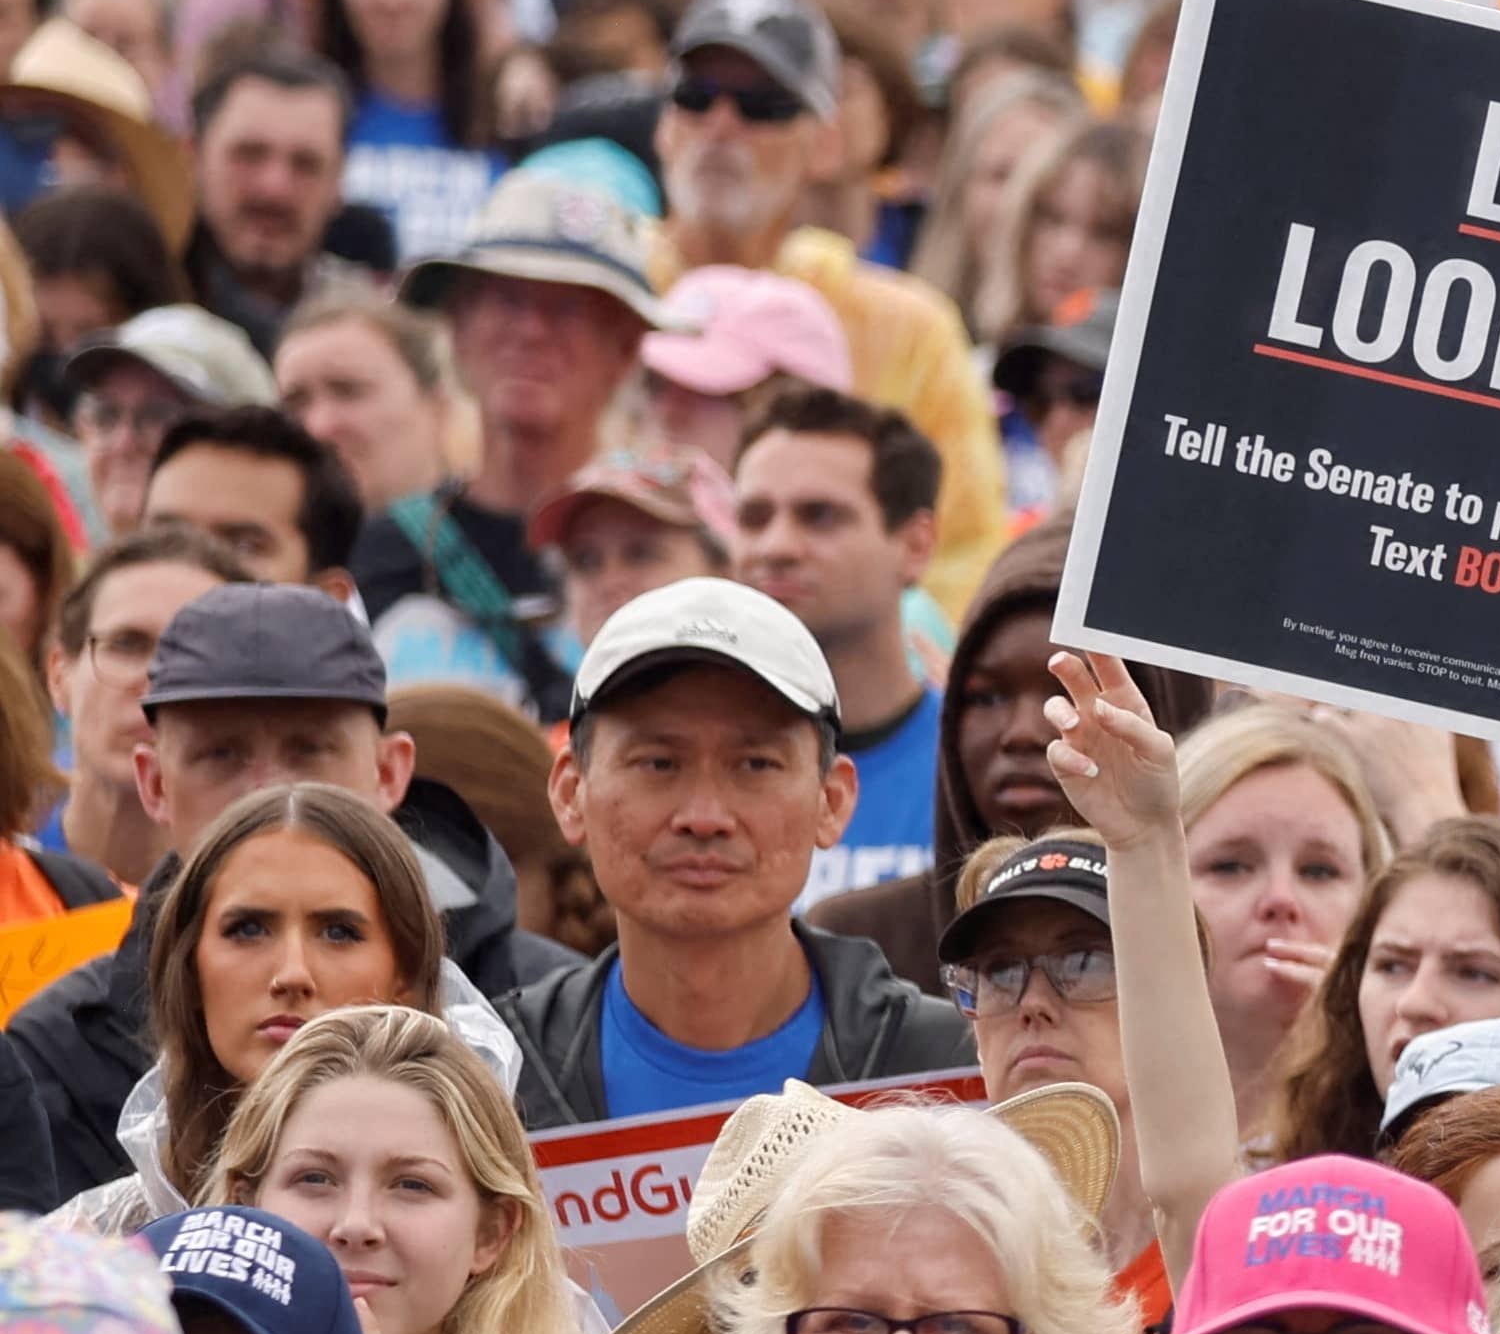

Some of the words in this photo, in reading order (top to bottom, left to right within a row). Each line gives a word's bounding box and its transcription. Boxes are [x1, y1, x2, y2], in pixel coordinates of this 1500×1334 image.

[1164, 414, 1227, 467] Tell
[1235, 435, 1295, 482] the
[1304, 448, 1434, 513] Senate
[1445, 483, 1483, 525] to
[1370, 525, 1447, 581] Text
[1282, 617, 1298, 631] By
[1299, 621, 1337, 640] texting,
[1338, 632, 1358, 644] you
[1359, 637, 1390, 651] agree
[1390, 642, 1403, 654] to
[1403, 647, 1441, 663] receive
[1334, 642, 1358, 660] Msg
[1359, 648, 1381, 665] freq
[1382, 656, 1415, 671] varies.
[1416, 662, 1448, 677] STOP
[1448, 669, 1460, 681] to
[1461, 674, 1485, 687] quit.
[1257, 1183, 1386, 1216] MARCH
[179, 1210, 283, 1250] MARCH
[1245, 1232, 1343, 1267] LIVES
[1248, 1208, 1317, 1242] FOR
[1328, 1209, 1403, 1249] OUR
[159, 1249, 253, 1283] LIVES
[168, 1228, 233, 1252] FOR
[233, 1238, 296, 1284] OUR
